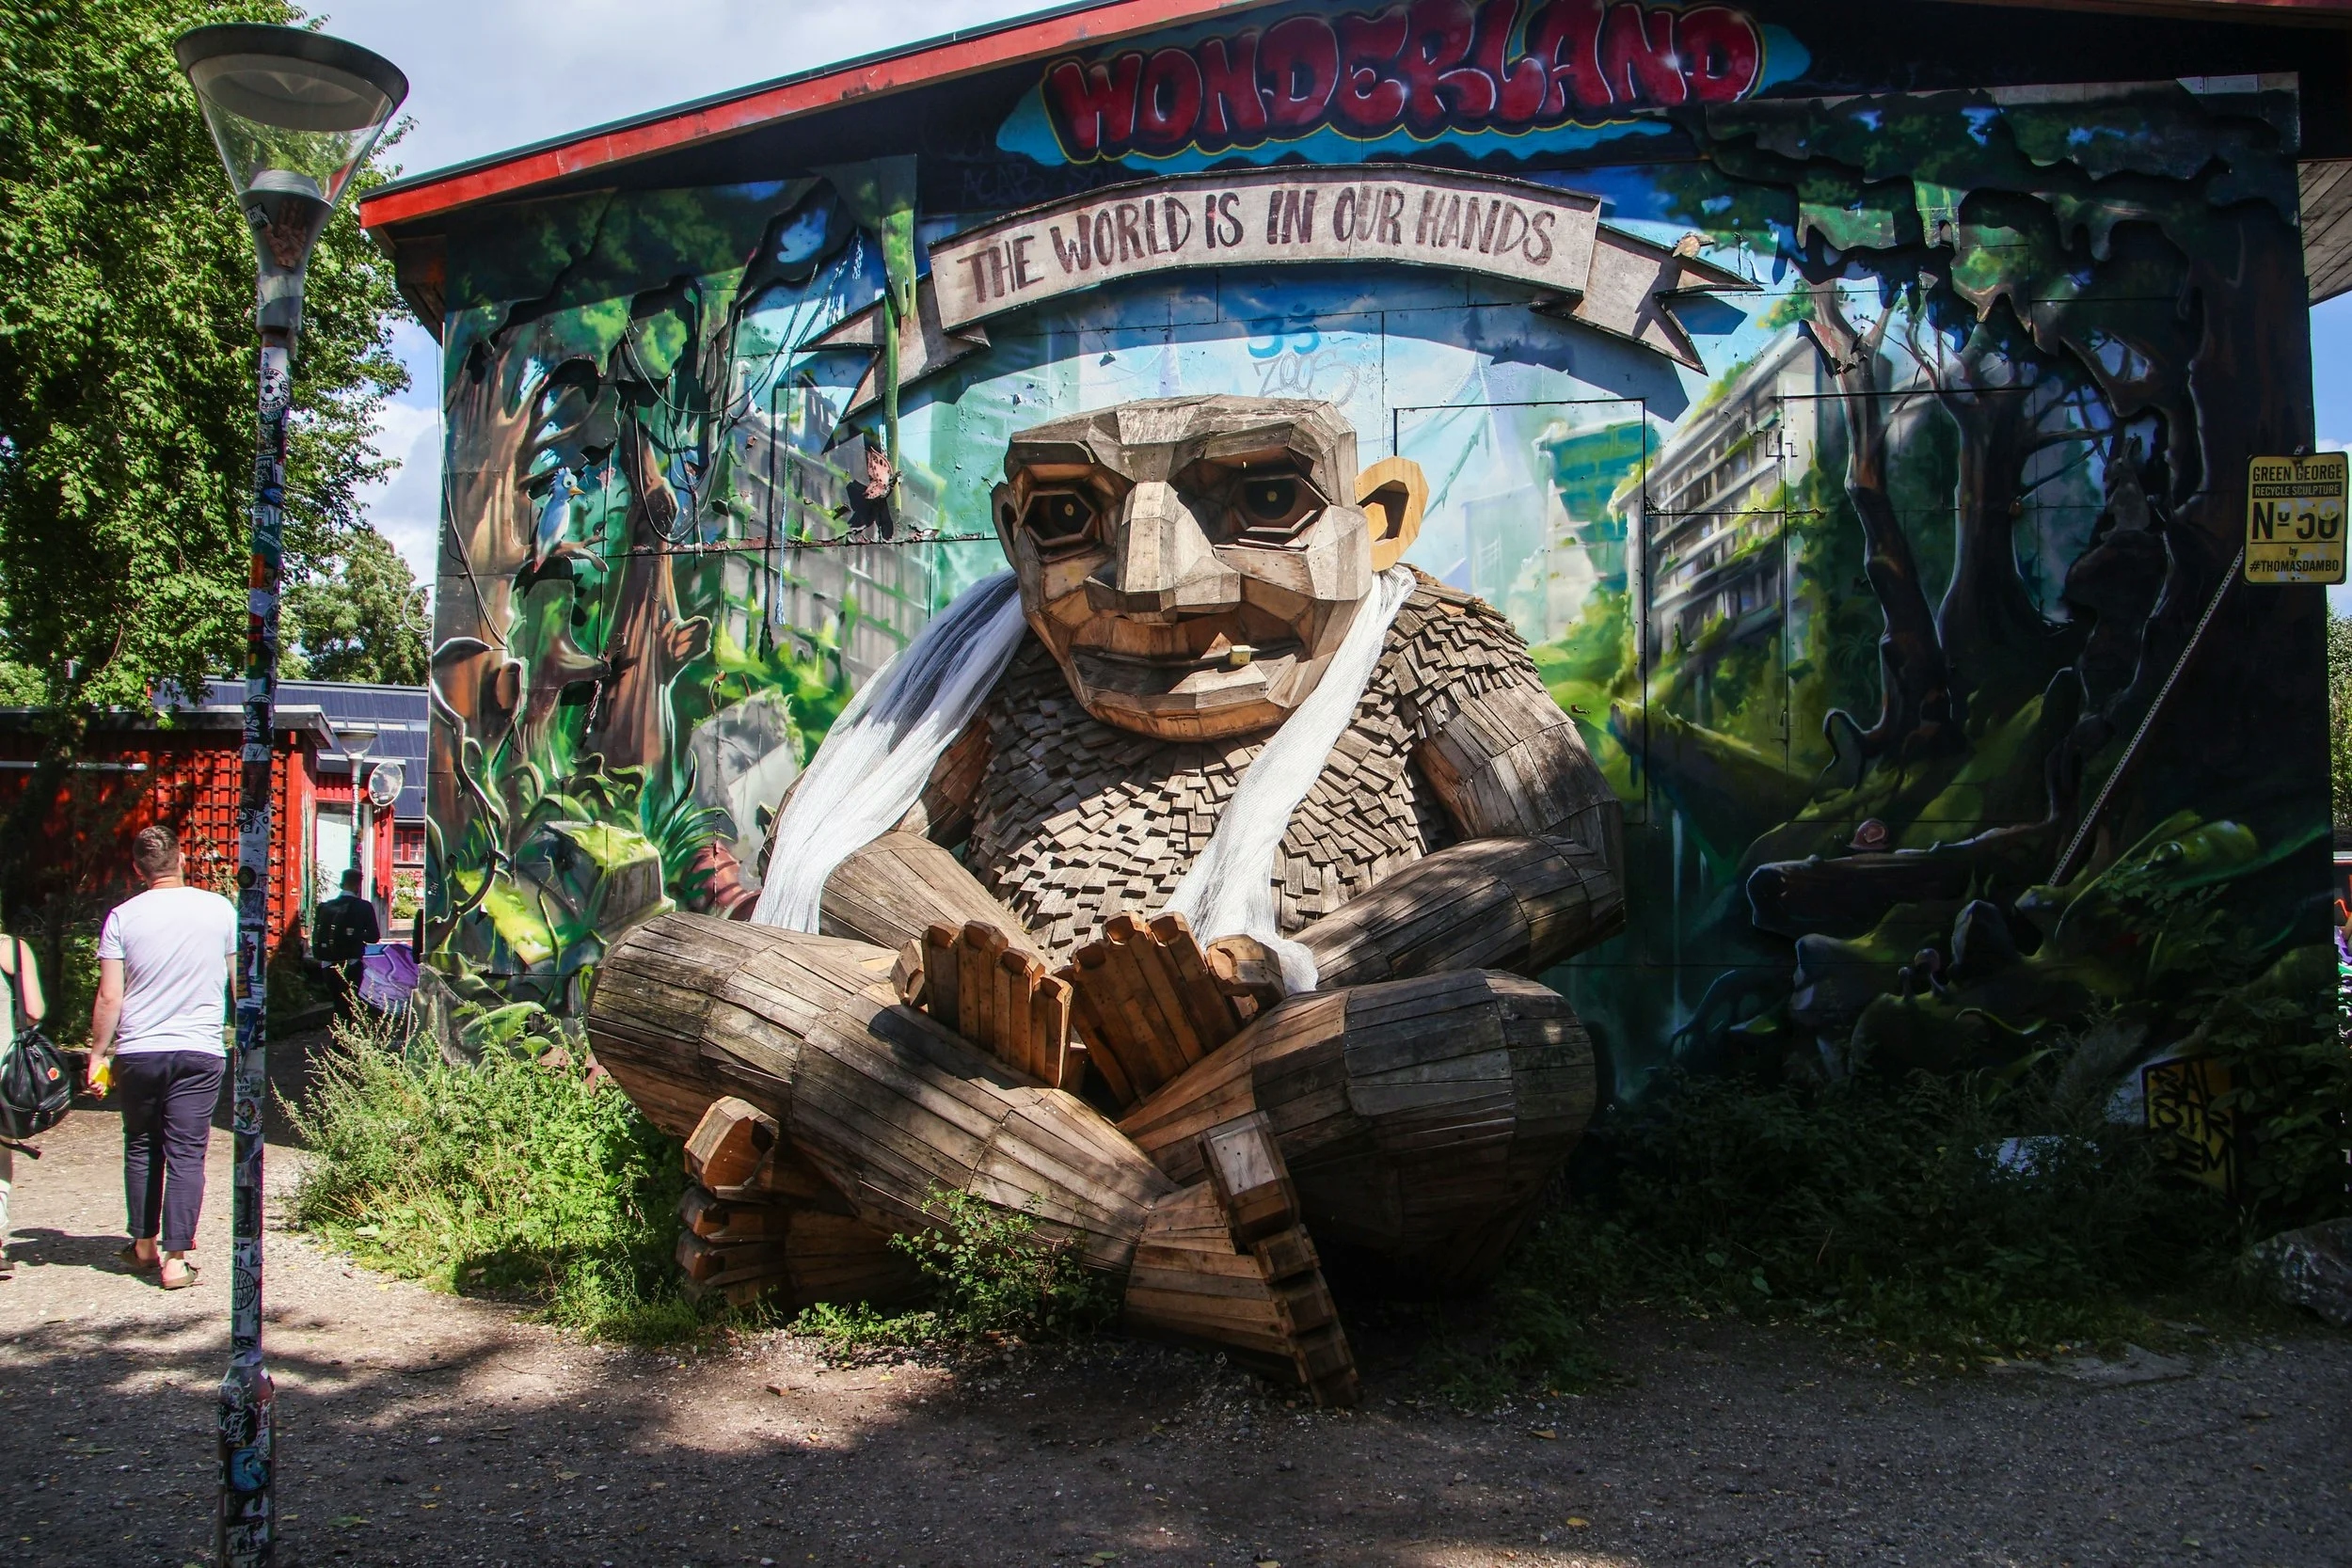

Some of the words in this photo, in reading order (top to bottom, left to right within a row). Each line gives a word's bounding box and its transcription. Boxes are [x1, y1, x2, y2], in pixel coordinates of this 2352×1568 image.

[1050, 0, 1761, 150] WONDERLAND
[957, 234, 1044, 303] THE
[1050, 196, 1191, 274] WORLD
[1205, 191, 1244, 249] IS
[1266, 189, 1317, 245] IN
[1333, 186, 1405, 246] OUR
[1416, 189, 1555, 265] HANDS
[2252, 466, 2291, 482] GREEN
[2296, 464, 2342, 481] GEORGE
[2255, 485, 2290, 497] RECYCLE
[2291, 484, 2339, 496] SCULPTURE
[2289, 546, 2298, 557] by
[2249, 559, 2339, 573] #THOMASDAMBO
